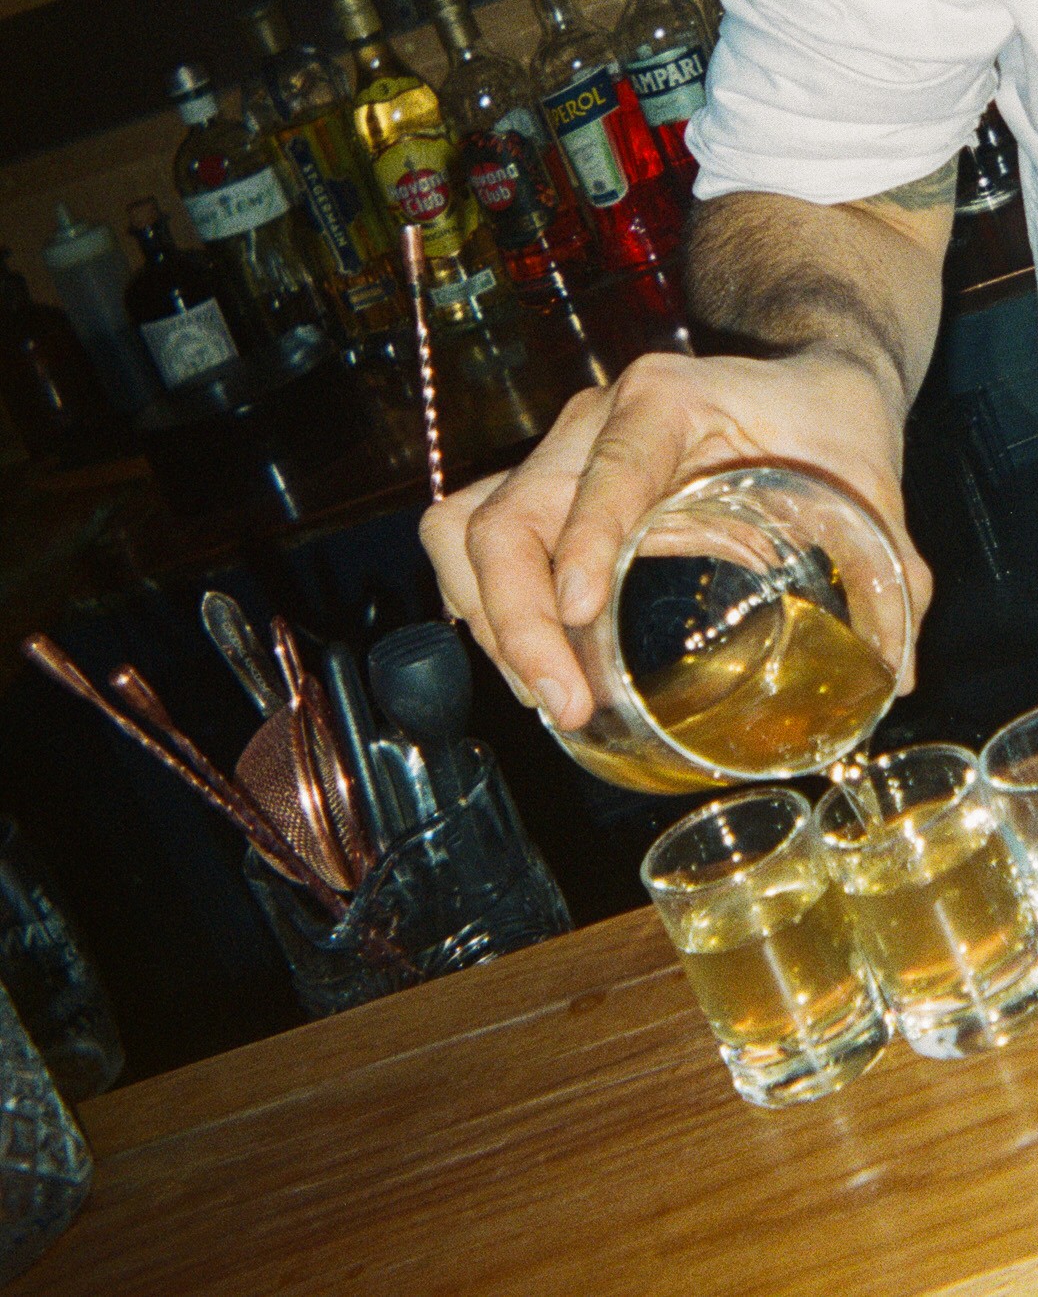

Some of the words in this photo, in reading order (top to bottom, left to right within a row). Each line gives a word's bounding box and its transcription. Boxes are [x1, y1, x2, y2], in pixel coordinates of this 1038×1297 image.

[631, 53, 704, 94] AMPARI
[551, 86, 607, 129] PEROL
[406, 191, 445, 217] Club
